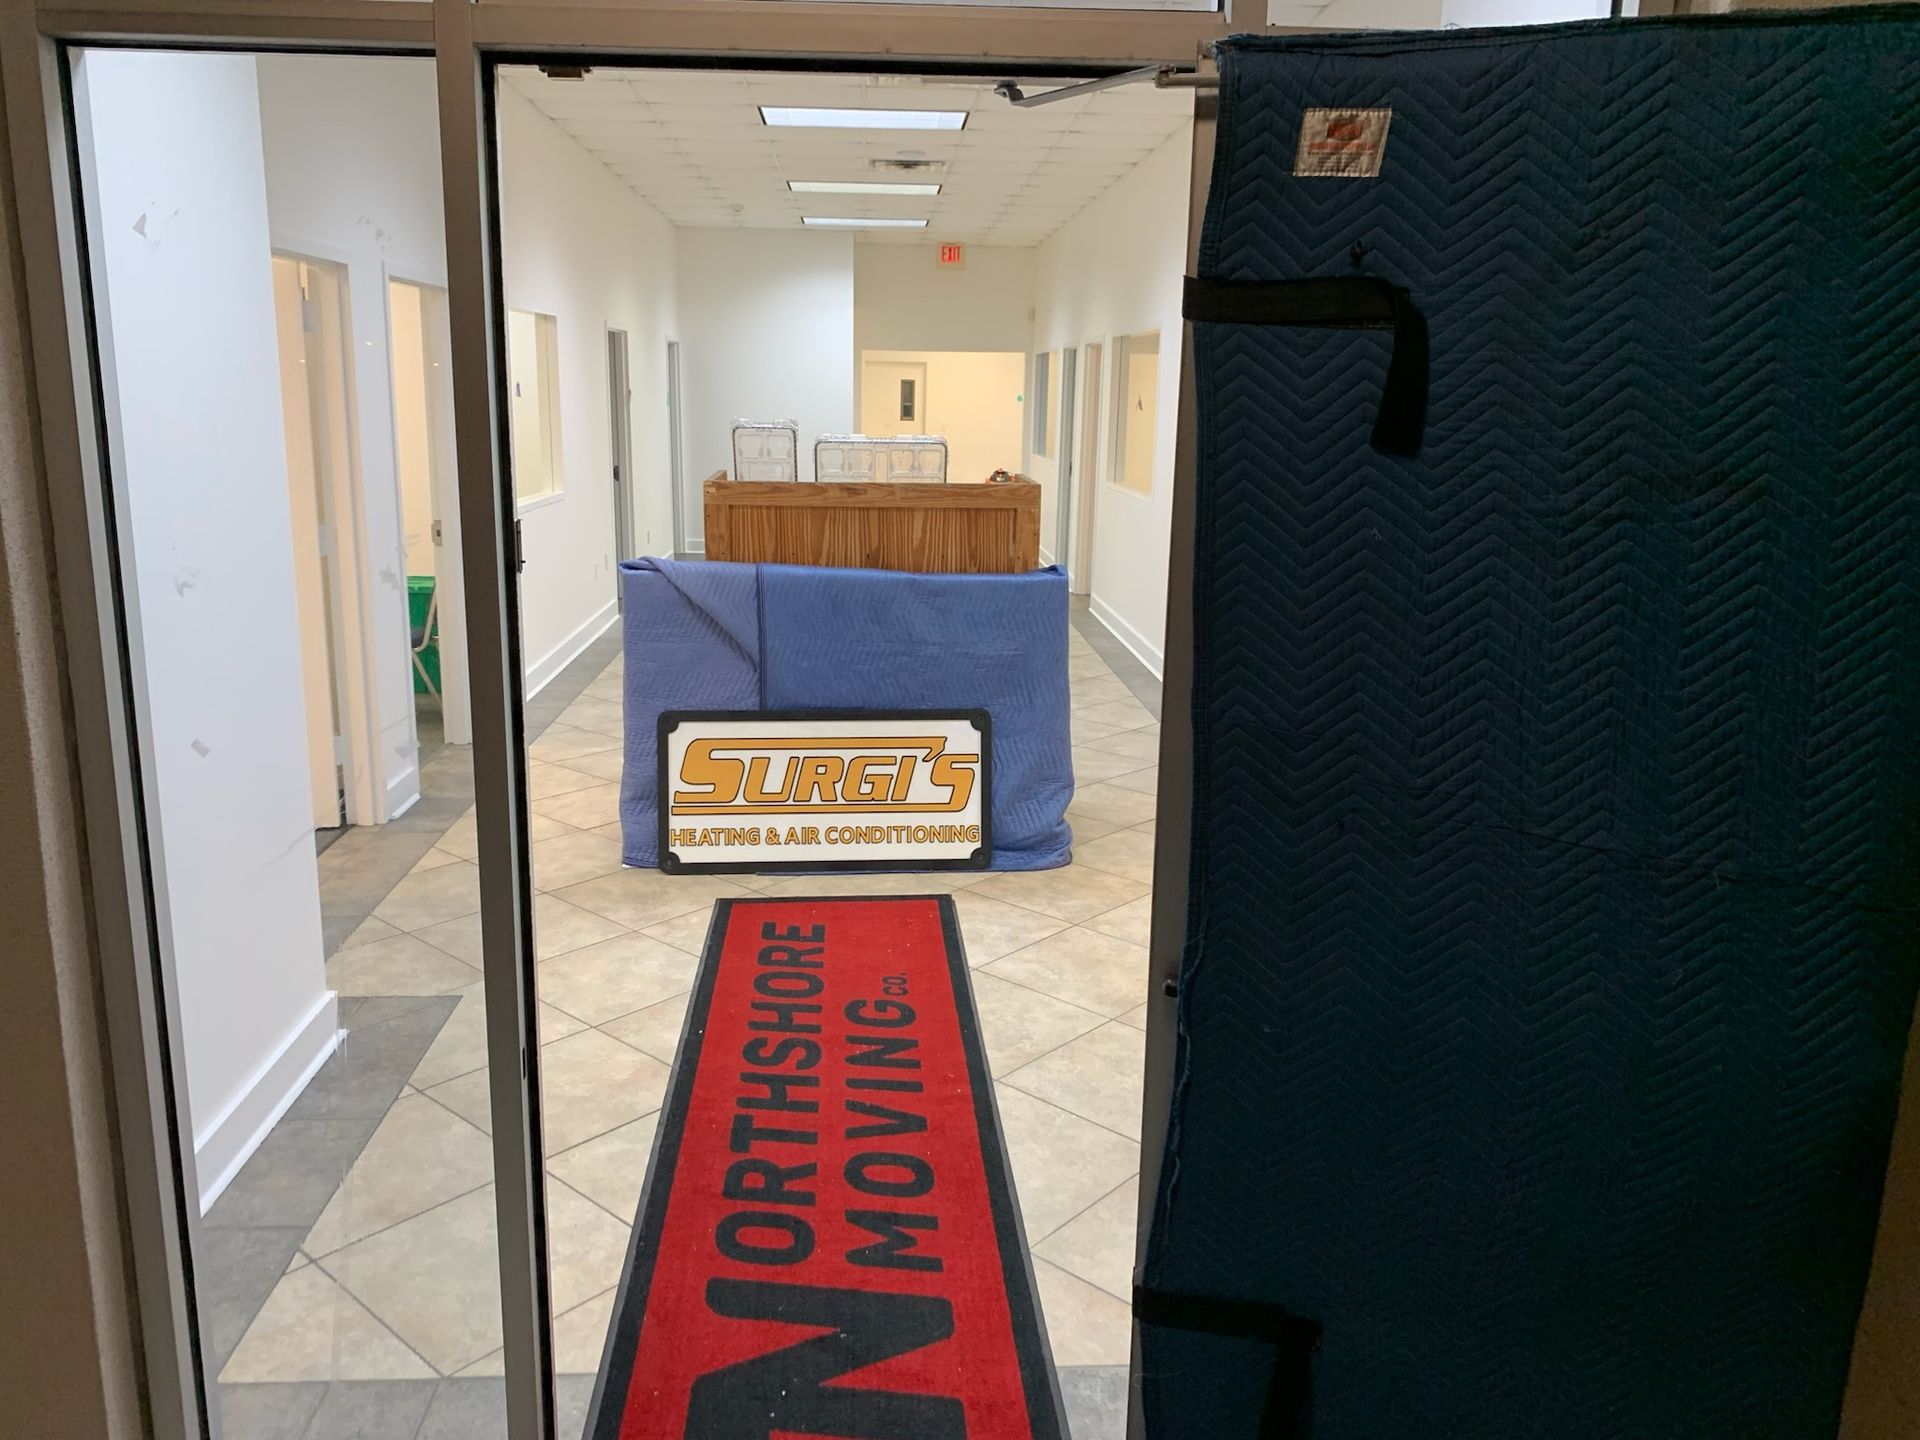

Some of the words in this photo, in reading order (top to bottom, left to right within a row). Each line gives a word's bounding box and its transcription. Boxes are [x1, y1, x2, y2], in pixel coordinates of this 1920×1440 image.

[941, 245, 961, 263] EXIT
[670, 827, 761, 847] HEATING
[765, 827, 781, 846] &
[784, 826, 821, 845] AIR
[824, 825, 980, 844] CONDITIONING
[843, 999, 944, 1272] MOVING
